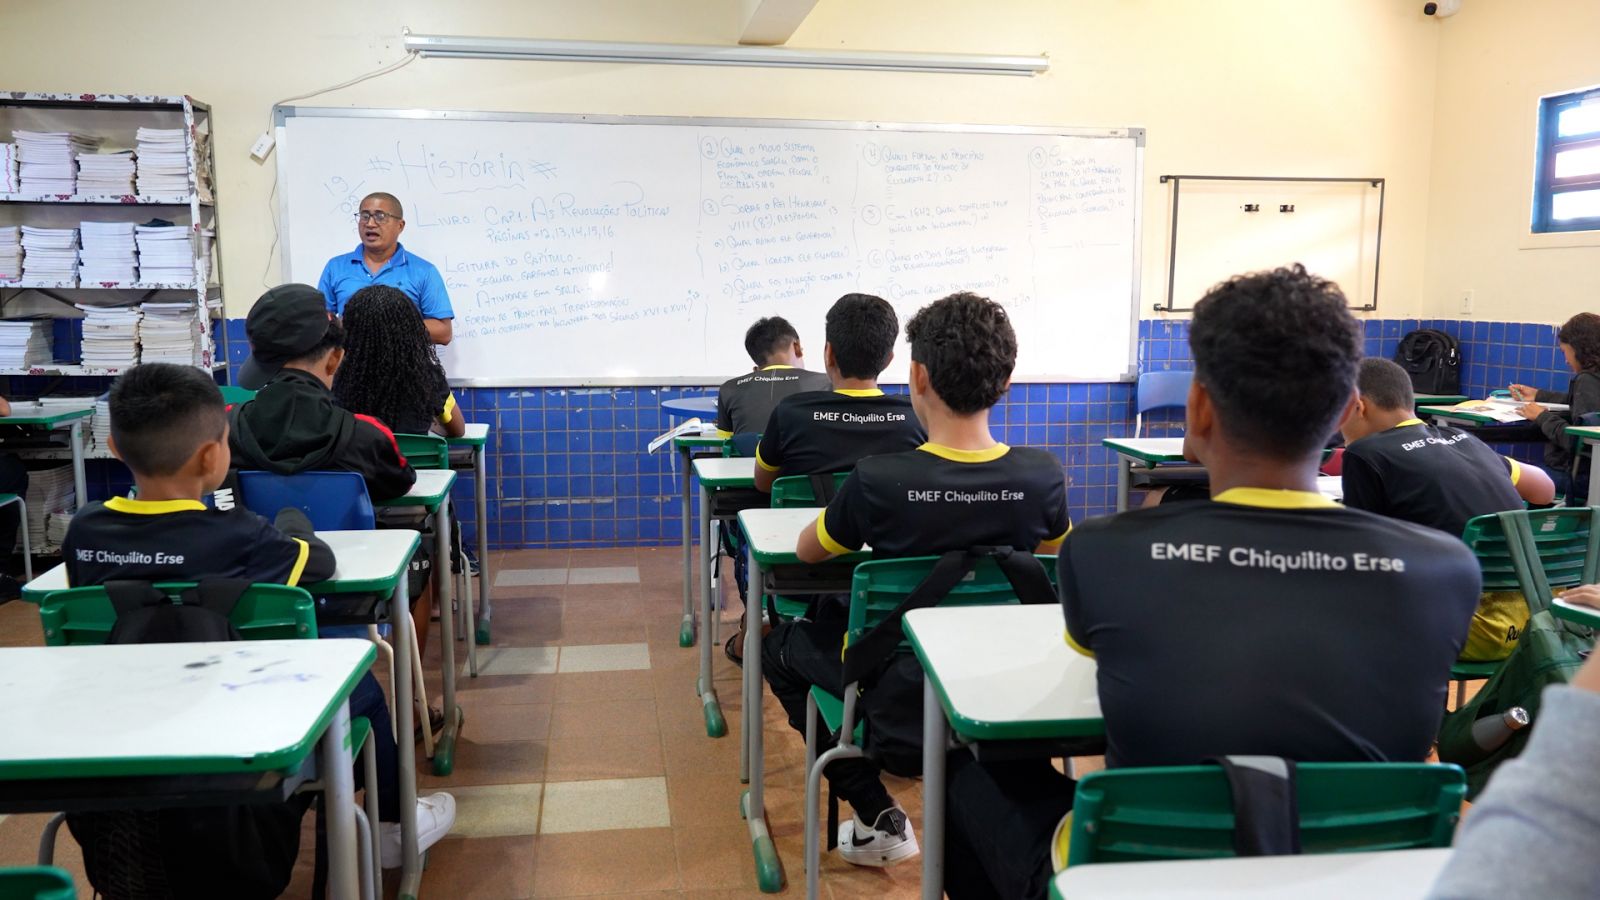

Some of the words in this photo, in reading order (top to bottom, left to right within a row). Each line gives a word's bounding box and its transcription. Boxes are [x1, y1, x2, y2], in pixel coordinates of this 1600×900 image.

[813, 411, 840, 423] EMEF
[842, 411, 885, 425] Chiquilito
[886, 411, 906, 422] Erse
[907, 489, 942, 503] EMEF
[944, 489, 999, 505] Chiquilito
[1000, 489, 1025, 502] Erse
[95, 549, 152, 565] Chiquilito
[154, 551, 184, 565] Erse
[1150, 541, 1223, 563] EMEF
[1228, 545, 1348, 574] Chiquilito
[1353, 552, 1406, 573] Erse
